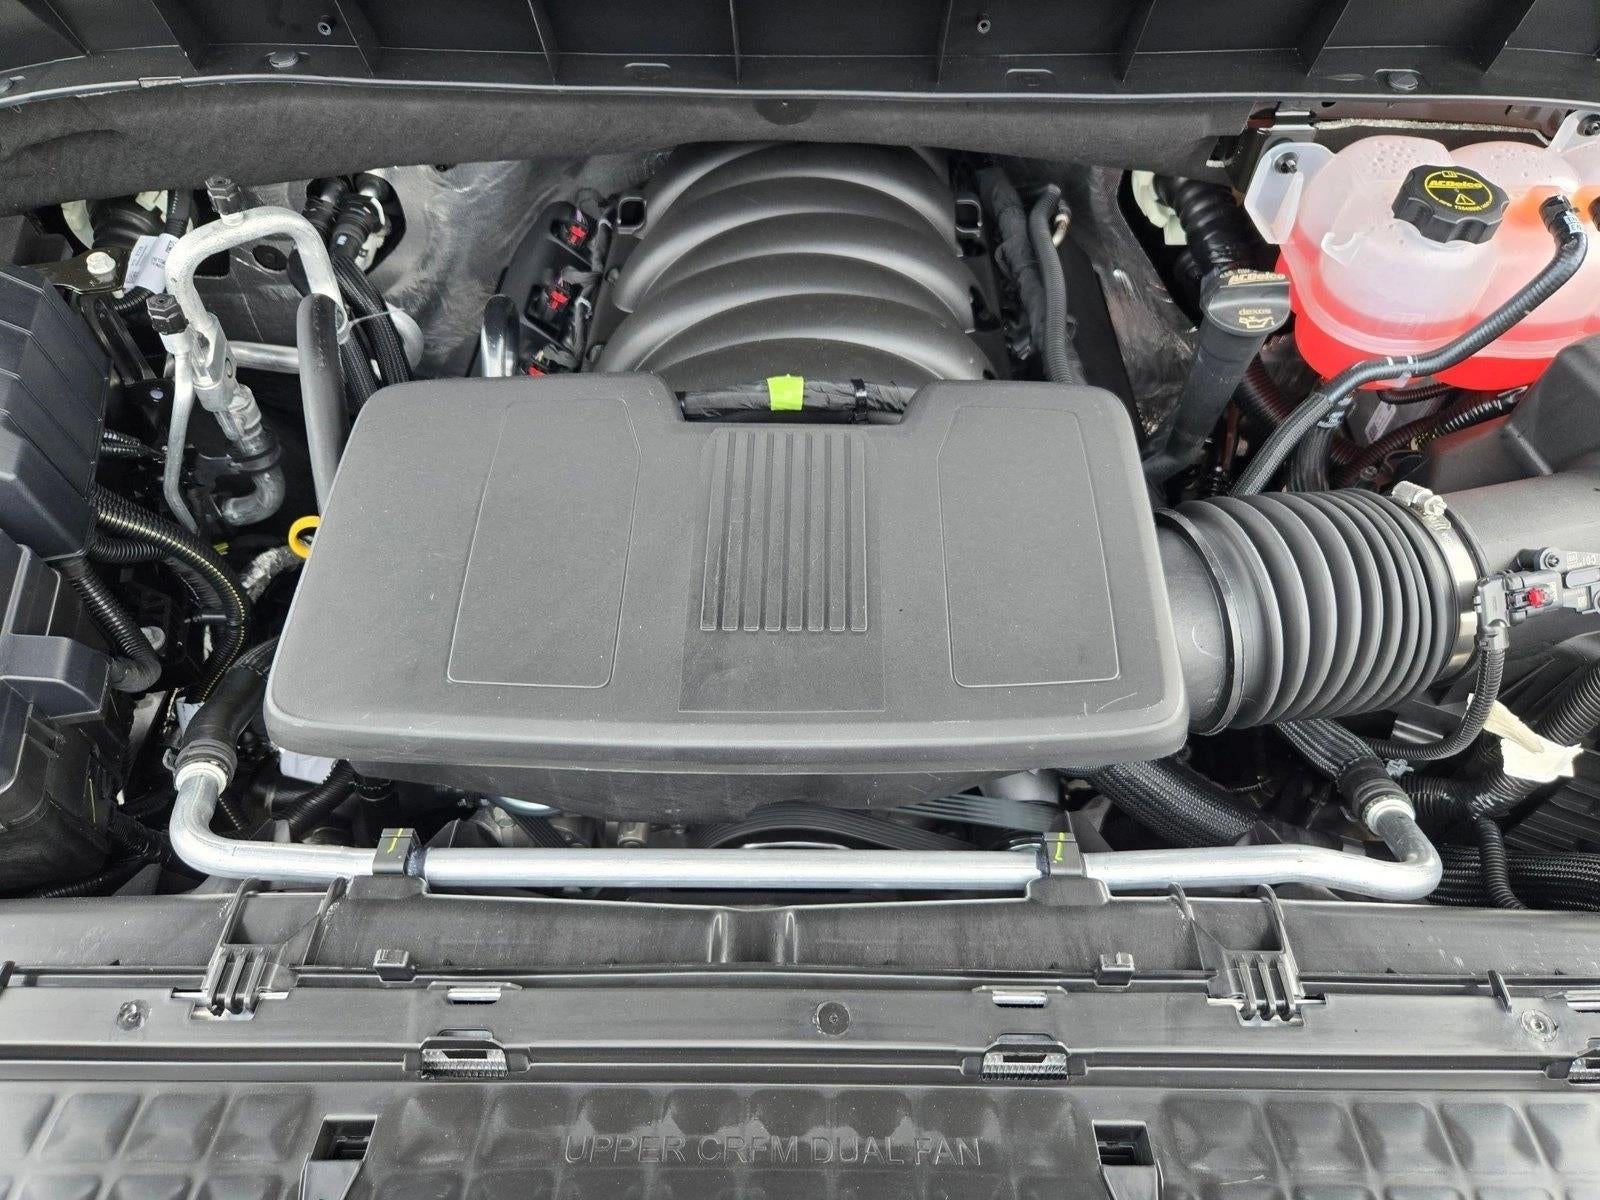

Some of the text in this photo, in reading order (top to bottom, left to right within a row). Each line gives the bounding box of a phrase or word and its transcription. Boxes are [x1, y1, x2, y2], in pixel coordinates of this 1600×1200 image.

[1427, 180, 1484, 189] ACDelco
[565, 1134, 981, 1166] UPPER CRFM DUAL FAN
